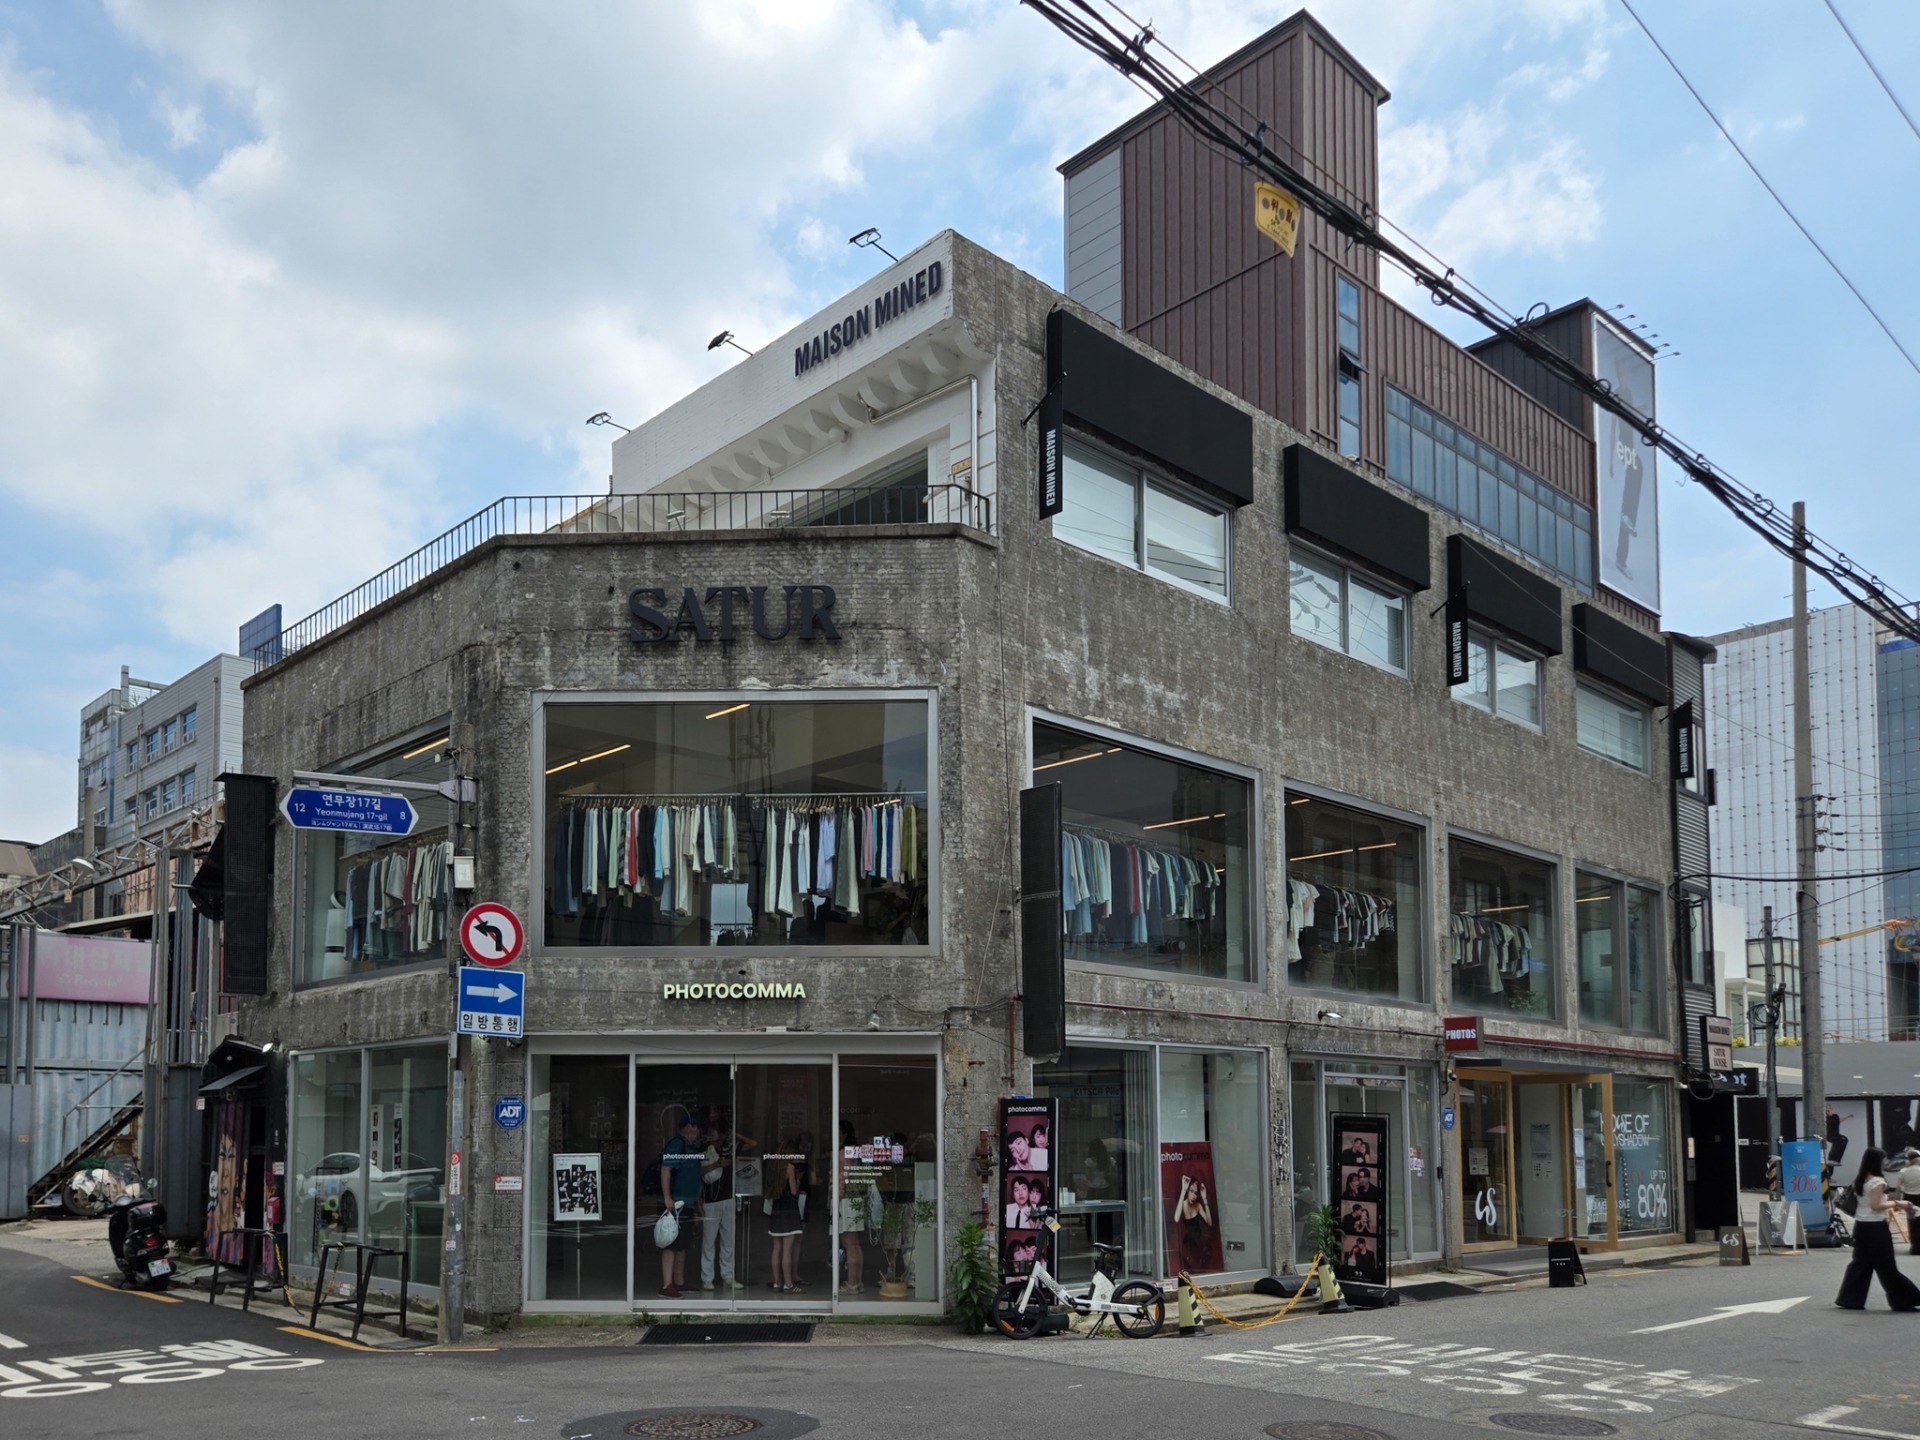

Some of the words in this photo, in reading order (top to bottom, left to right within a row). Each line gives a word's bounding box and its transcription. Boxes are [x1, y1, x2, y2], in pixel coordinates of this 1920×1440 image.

[794, 304, 869, 377] MAISON
[874, 260, 942, 329] MINED
[1045, 429, 1056, 472] MAISON
[1616, 440, 1638, 470] ept
[1045, 471, 1056, 507] MINED
[628, 584, 843, 643] SATUR
[1451, 621, 1462, 653] MAISON
[1452, 652, 1463, 678] MINED
[294, 803, 306, 812] 12
[321, 794, 382, 811] 연무장17길
[315, 808, 365, 820] Yeonmujang
[366, 811, 388, 822] 17-gil
[399, 811, 406, 820] 8
[663, 983, 807, 999] PHOTOCOMMA
[462, 1013, 518, 1032] 일방통행
[1445, 1029, 1477, 1039] PHOTOS
[499, 1105, 522, 1119] ADT
[1007, 1105, 1048, 1114] photocomma
[1634, 1113, 1650, 1133] OF
[662, 1153, 705, 1161] photocomma
[762, 1153, 806, 1161] photocomma
[1650, 1170, 1658, 1180] UP
[1787, 1174, 1817, 1194] 30%
[1637, 1183, 1668, 1219] 80%
